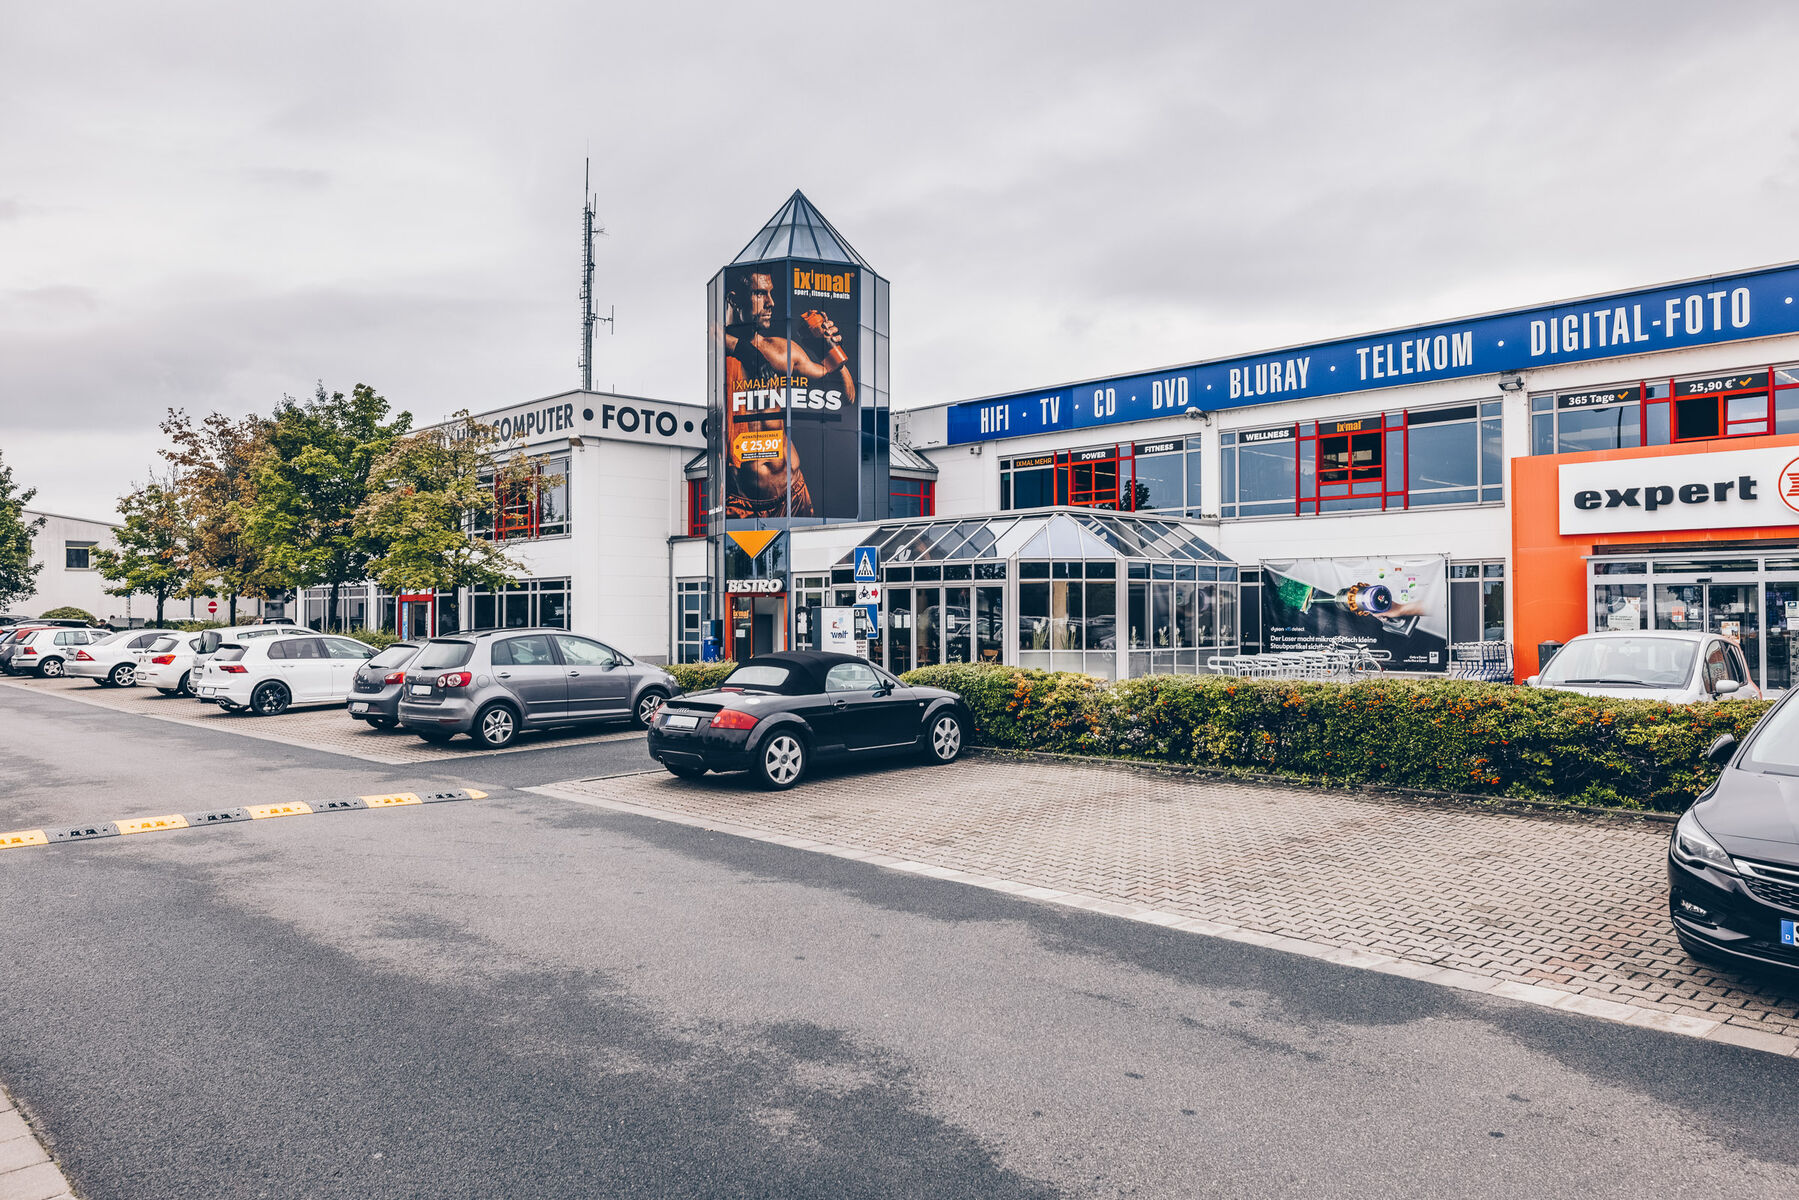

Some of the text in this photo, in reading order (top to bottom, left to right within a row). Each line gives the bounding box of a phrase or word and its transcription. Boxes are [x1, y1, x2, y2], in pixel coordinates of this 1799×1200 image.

[980, 287, 1751, 434] HIFI TV CD DVD BLURAY TELEKOM DIGITAL-FOTO
[732, 376, 809, 390] IXMAL MEHR
[1689, 381, 1723, 394] 25,90
[732, 387, 842, 412] FITNESS
[1568, 393, 1615, 406] 365 Tage
[491, 402, 575, 444] COMPUTER
[602, 404, 678, 437] FOTO
[1245, 429, 1290, 442] WELLNESS
[741, 440, 749, 452] €
[1144, 443, 1174, 454] FITNESS
[1016, 457, 1052, 468] IXMAL MEHR
[1081, 451, 1106, 461] POWER
[1573, 475, 1758, 512] expert
[1358, 635, 1377, 643] kleine
